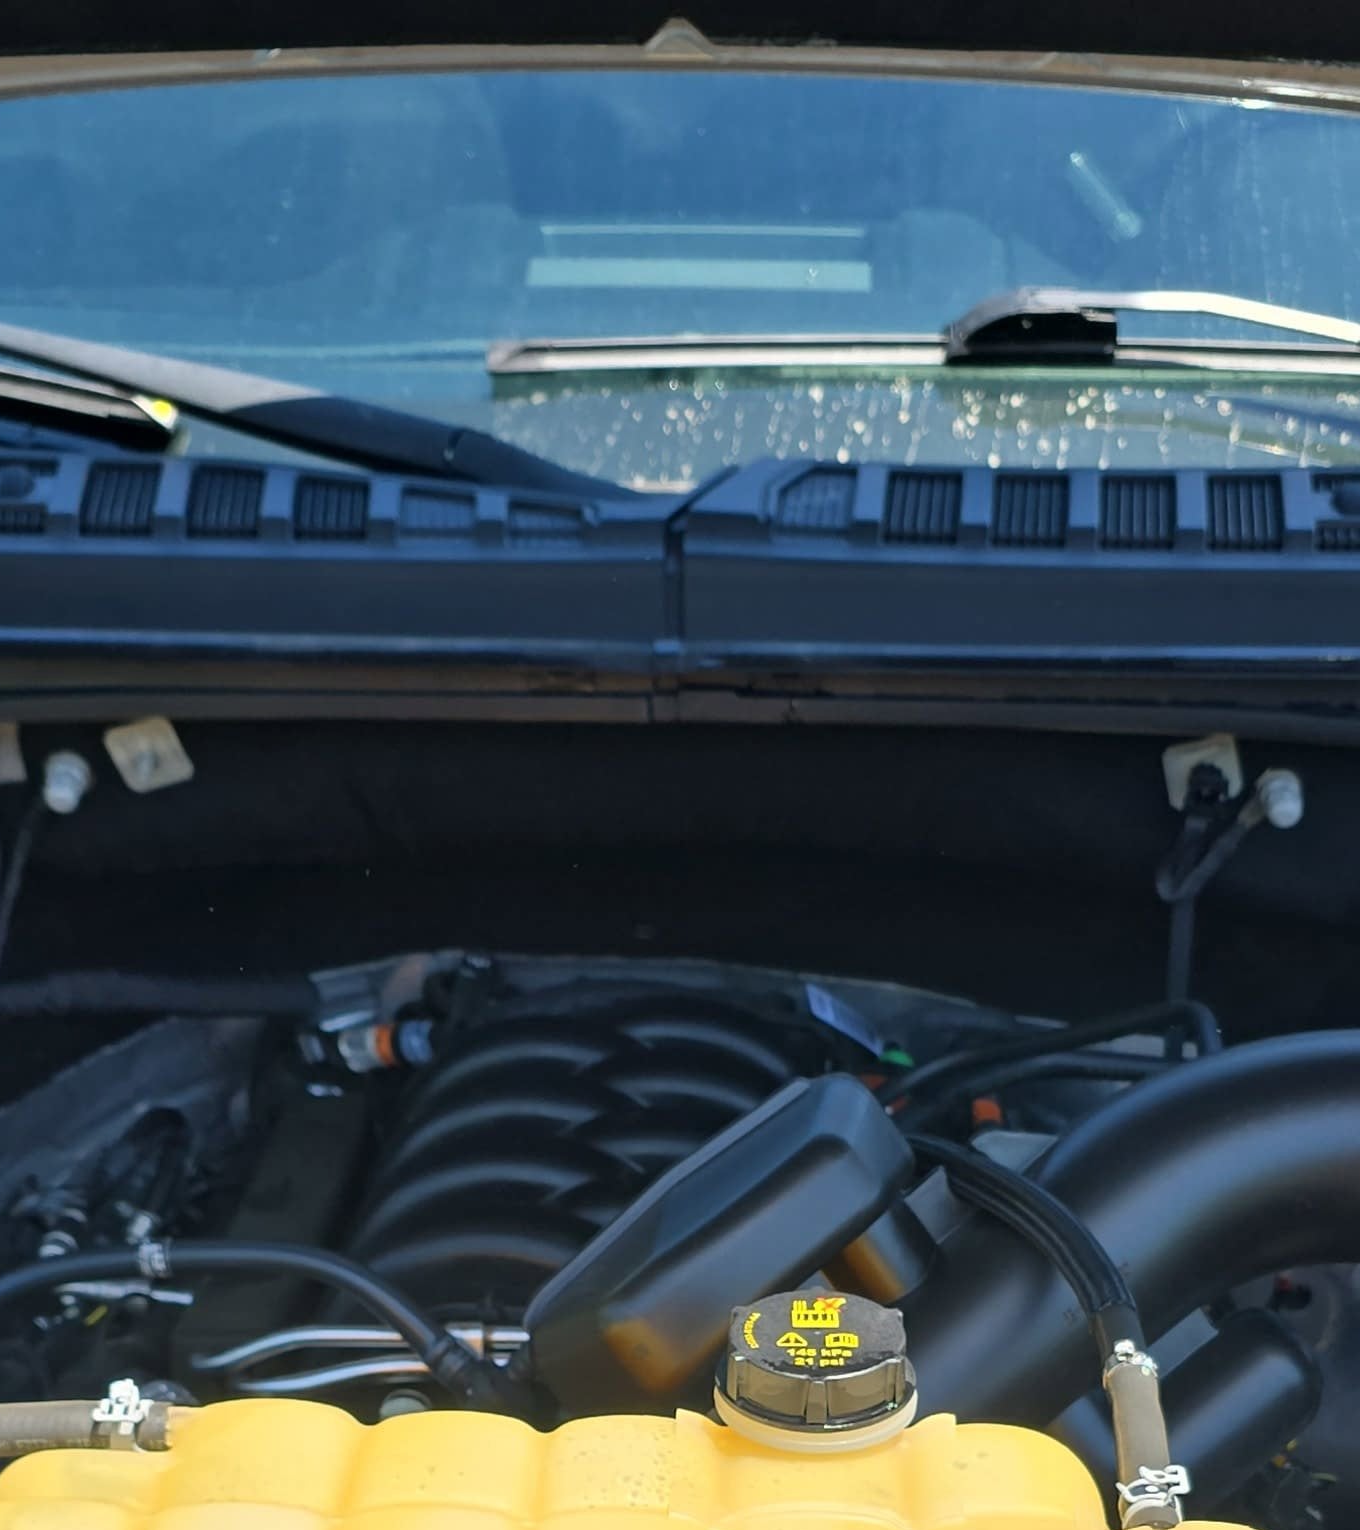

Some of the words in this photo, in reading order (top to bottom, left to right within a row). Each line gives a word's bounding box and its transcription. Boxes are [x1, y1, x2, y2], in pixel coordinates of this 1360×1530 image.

[786, 1348, 817, 1356] 145
[820, 1349, 853, 1357] kPa
[794, 1357, 814, 1366] 21
[819, 1357, 845, 1367] psi
